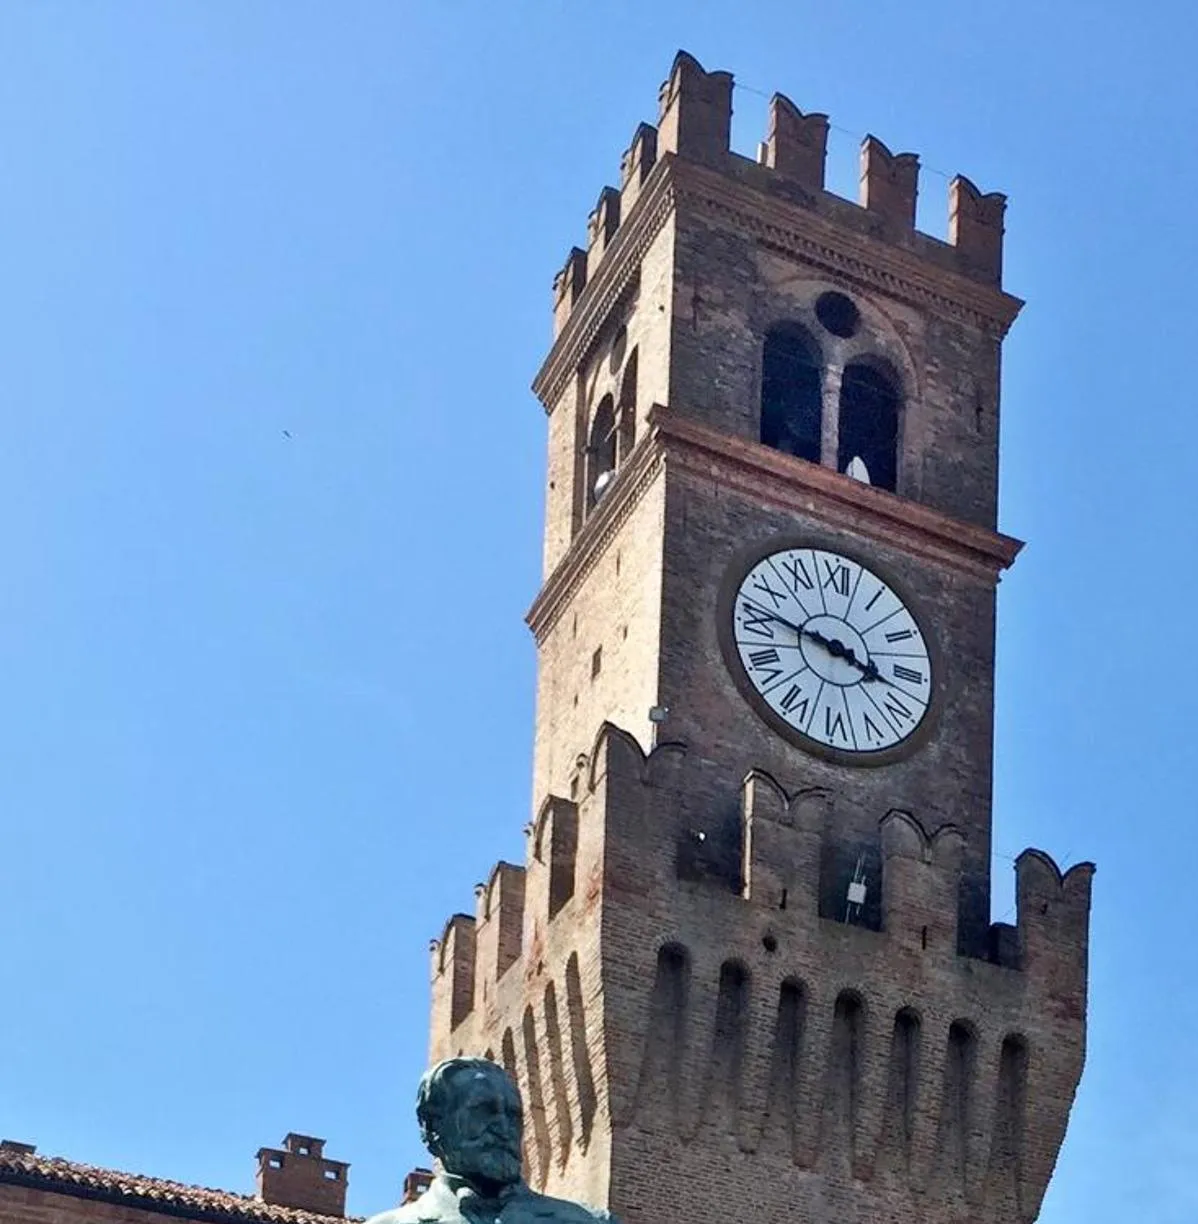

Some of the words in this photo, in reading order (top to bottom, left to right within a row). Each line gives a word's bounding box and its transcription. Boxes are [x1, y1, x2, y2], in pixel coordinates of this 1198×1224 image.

[753, 574, 787, 608] X
[823, 559, 850, 596] XII
[863, 711, 884, 741] V
